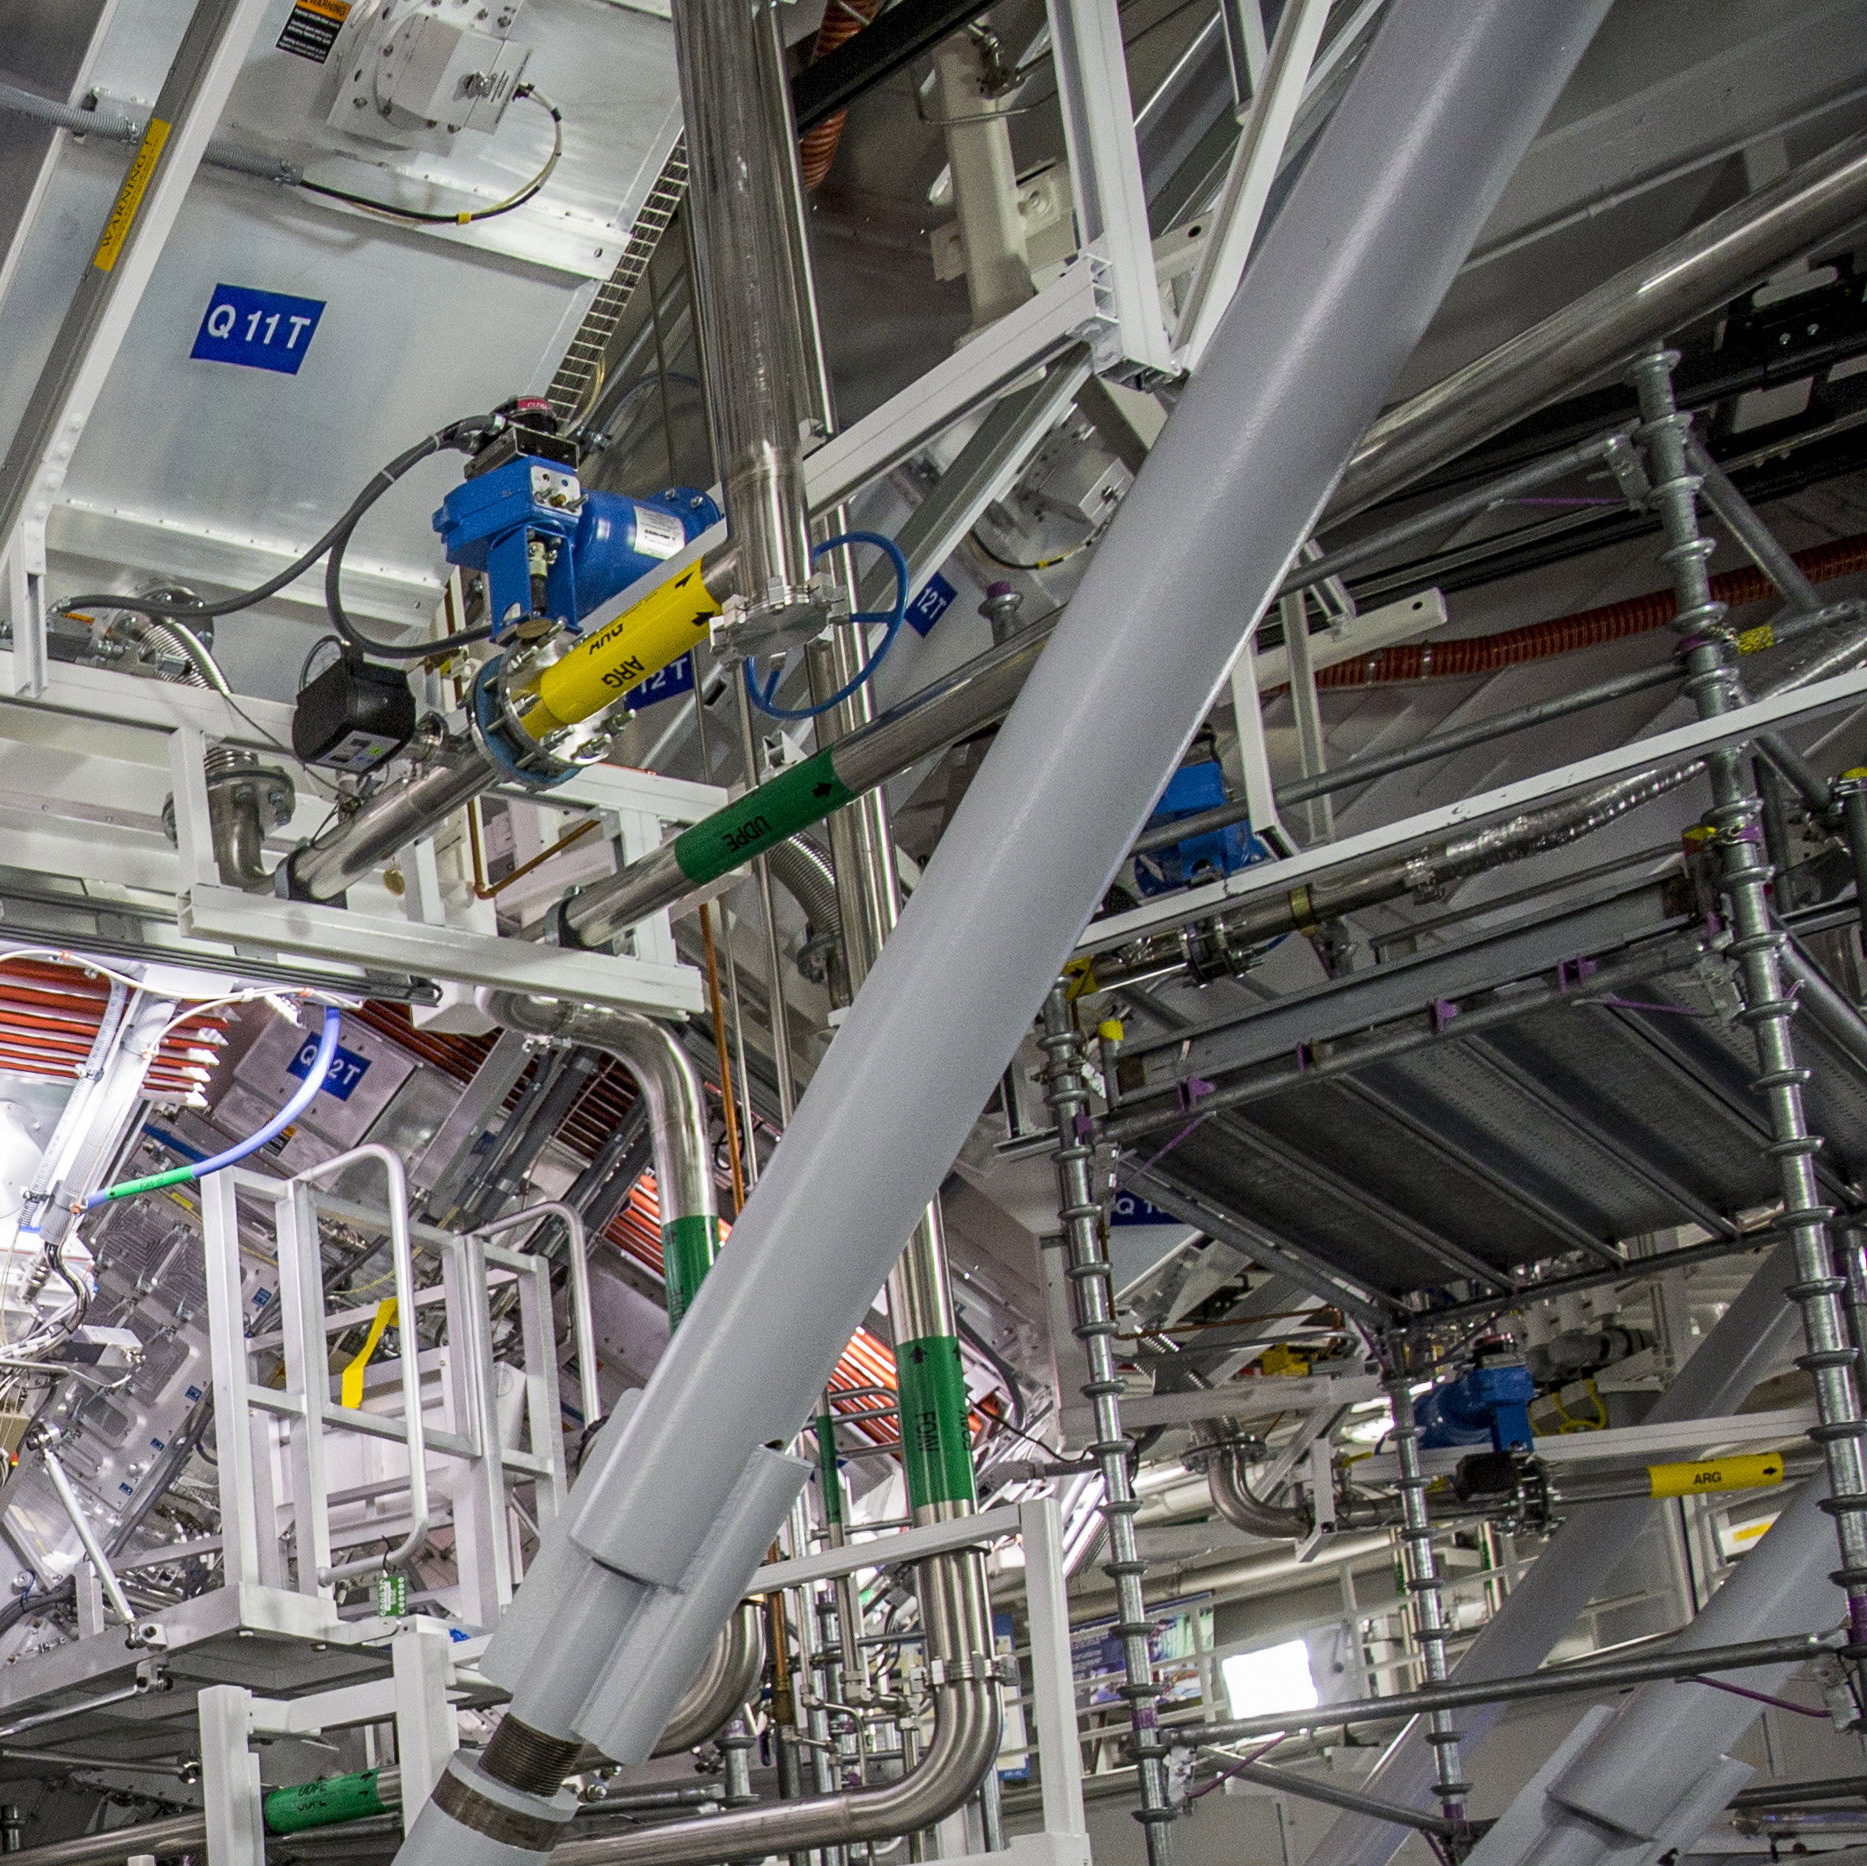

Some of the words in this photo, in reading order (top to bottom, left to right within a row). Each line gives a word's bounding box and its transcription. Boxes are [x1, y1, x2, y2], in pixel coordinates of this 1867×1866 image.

[206, 303, 238, 340] Q
[246, 309, 282, 345] 11
[288, 314, 313, 350] T
[599, 653, 647, 690] ARG
[669, 656, 688, 682] T
[342, 1064, 361, 1086] T
[1116, 1196, 1136, 1215] Q
[1693, 1470, 1723, 1486] ARG
